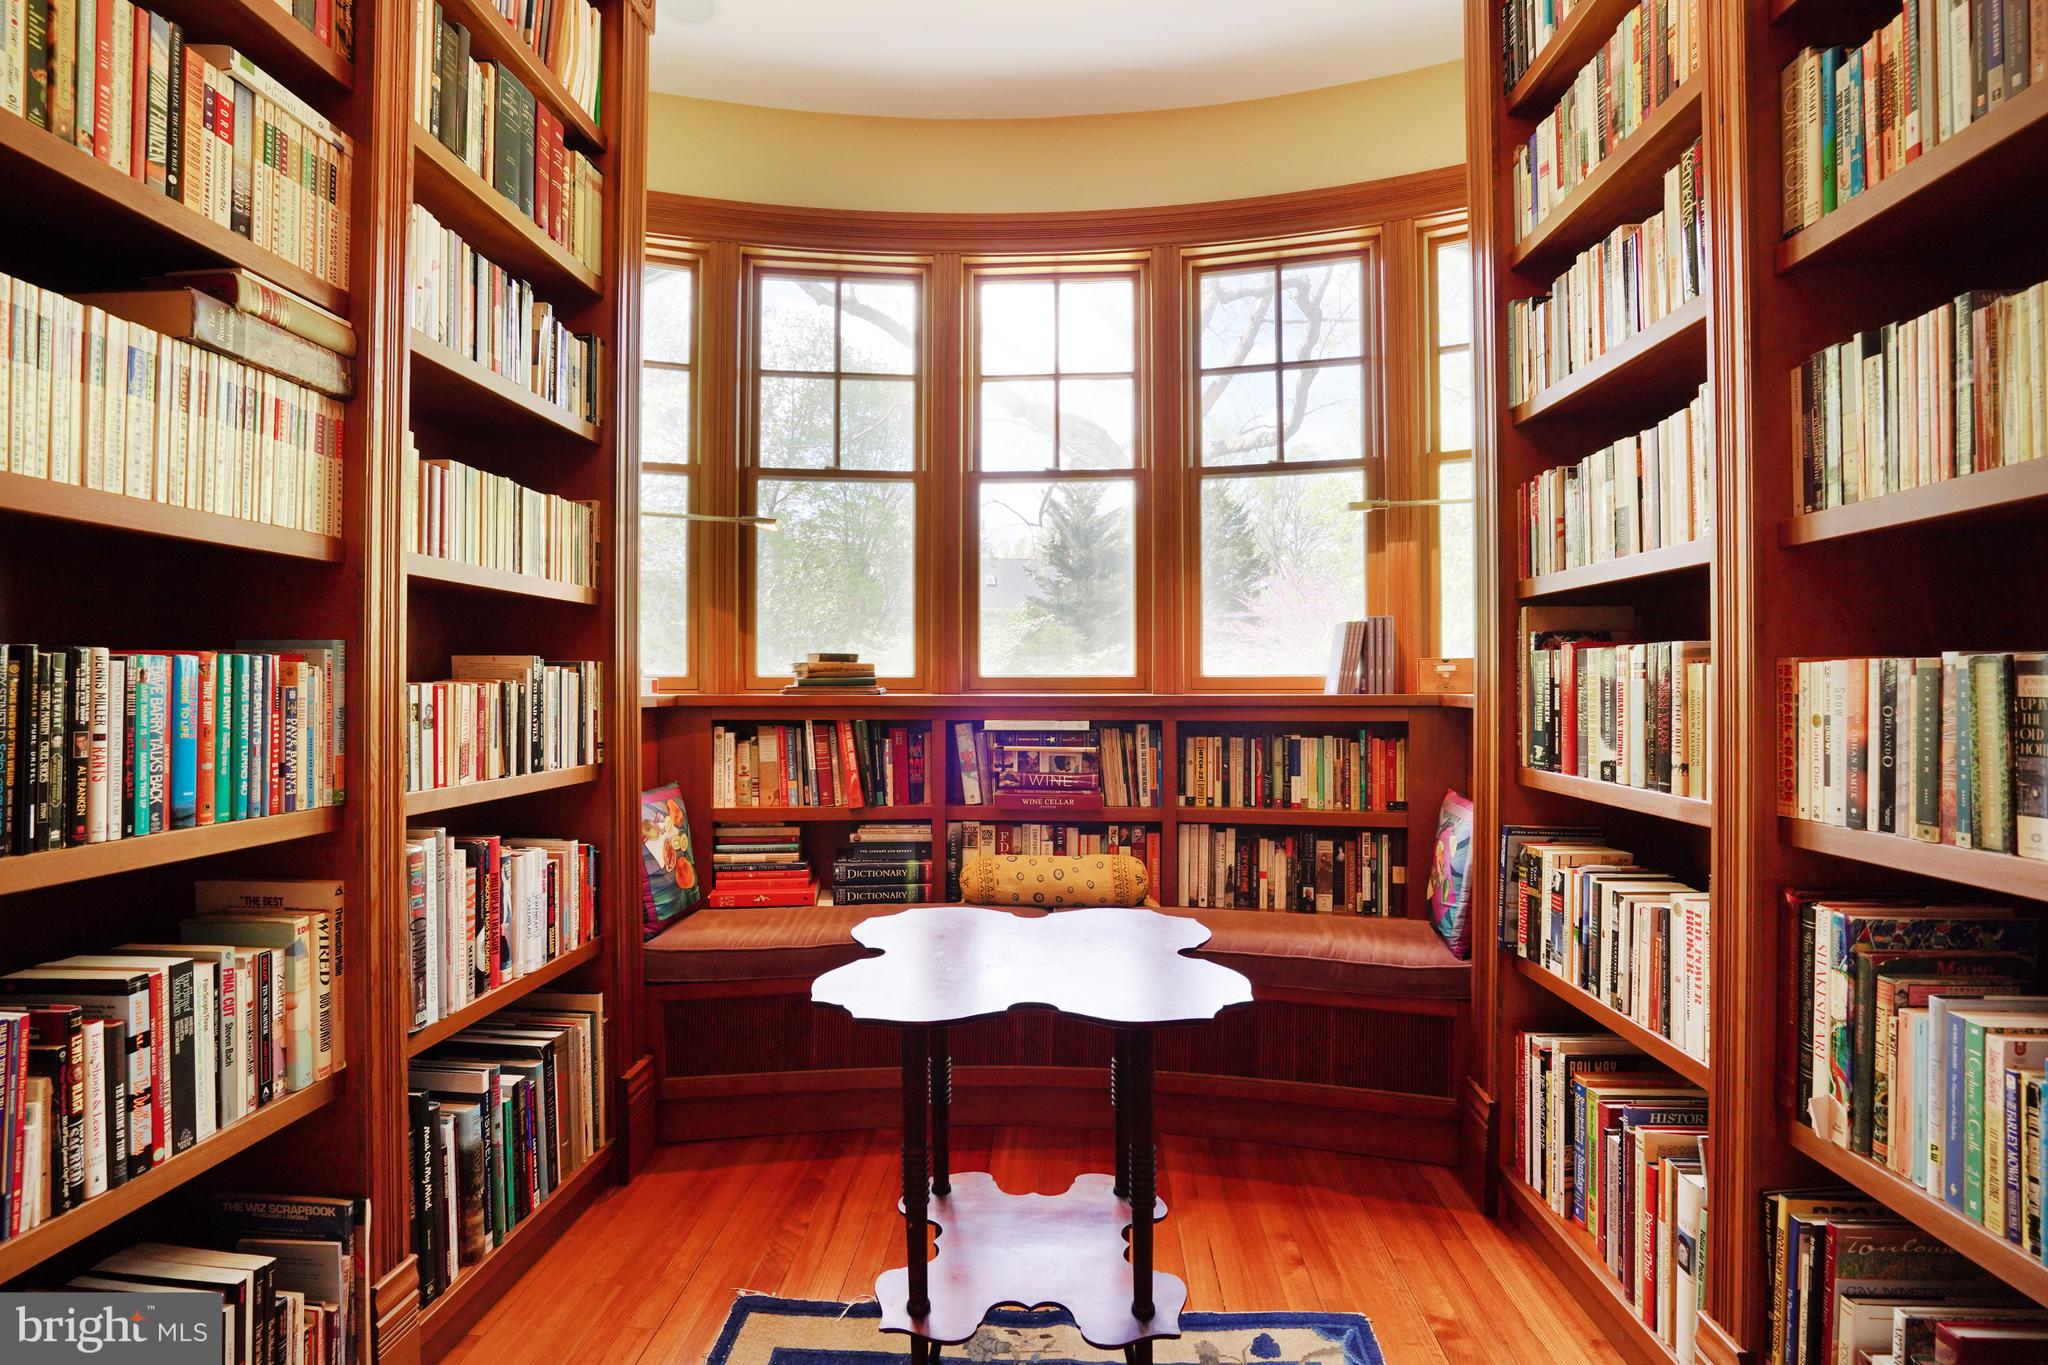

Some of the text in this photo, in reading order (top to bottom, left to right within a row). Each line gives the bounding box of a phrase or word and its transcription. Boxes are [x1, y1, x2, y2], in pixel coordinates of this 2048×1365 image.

[172, 32, 180, 65] MICHAEL
[172, 67, 180, 107] ONDAATJE
[150, 112, 167, 163] FRANZEN
[219, 99, 230, 138] FORD
[1681, 147, 1697, 228] Kennedys
[9, 680, 17, 704] MORE
[53, 667, 63, 728] JON STEWART
[94, 656, 106, 726] DENNIS MILLER
[126, 668, 136, 716] DENNIS MILLER
[180, 676, 189, 739] GUIDE TO LIFE
[203, 681, 212, 726] DAVE BARRY
[223, 668, 231, 730] DAVE BARRY
[253, 661, 262, 745] DAVE BARRY'S
[532, 682, 540, 691] TO
[532, 693, 540, 714] READ
[1834, 687, 1845, 716] Snow
[40, 690, 50, 735] STEVE MARTIN
[149, 665, 166, 804] DAVE BARRY TALKS BACK
[241, 673, 249, 796] DAVE BARRY TURNS 40
[532, 722, 540, 742] FILM
[1674, 703, 1682, 723] THE
[1784, 665, 1793, 802] MICHAEL CHABON
[2019, 727, 2045, 741] OLD
[2022, 713, 2040, 726] THE
[7, 742, 15, 758] THE
[8, 731, 15, 741] OF
[1674, 728, 1682, 757] BIBLE
[1882, 705, 1894, 768] ORLANDO
[6, 759, 14, 786] WEIRD
[40, 741, 50, 783] CRUEL SHOES
[92, 747, 106, 782] RANTS
[126, 726, 134, 798] Ranting Again
[1027, 774, 1073, 786] WINE
[1197, 748, 1205, 780] HITCH-22
[1264, 773, 1273, 795] Them
[1849, 729, 1858, 799] ORHAN PAMUK
[77, 766, 87, 817] AL FRANKEN
[847, 868, 908, 879] DICTIONARY
[847, 890, 908, 901] DICTIONARY
[491, 871, 499, 956] PHOTOPLAY TREASURY
[1519, 880, 1528, 944] BUSHWORLD
[318, 918, 330, 985] WIRED
[410, 917, 427, 982] CINEMA
[223, 968, 235, 1017] FINAL CUT
[1815, 943, 1828, 1064] SHAKESPEARE
[225, 1022, 234, 1067] Steven Bach
[320, 991, 330, 1053] BOB WOODWARD
[71, 1034, 83, 1114] LEWIS BLACK
[92, 1062, 101, 1097] Shoots
[1966, 1056, 1982, 1100] Capture
[92, 1099, 101, 1111] &
[116, 1083, 125, 1161] THE MEANING OF TINGO
[1966, 1103, 1982, 1116] the
[92, 1113, 101, 1149] Leaves
[483, 1115, 493, 1166] ISRAEL
[1966, 1119, 1982, 1153] Castle
[2007, 1109, 2019, 1188] FARLEY MOWAT
[423, 1126, 432, 1211] Maui On My Mind
[1576, 1155, 1585, 1193] Sunday
[1989, 1127, 1999, 1203] LET YOUR MIND ALONE!
[1644, 1209, 1654, 1281] Picture This!
[1698, 1229, 1706, 1249] Folies
[1772, 1228, 1785, 1353] BROADWAY THEATRE POSTERS
